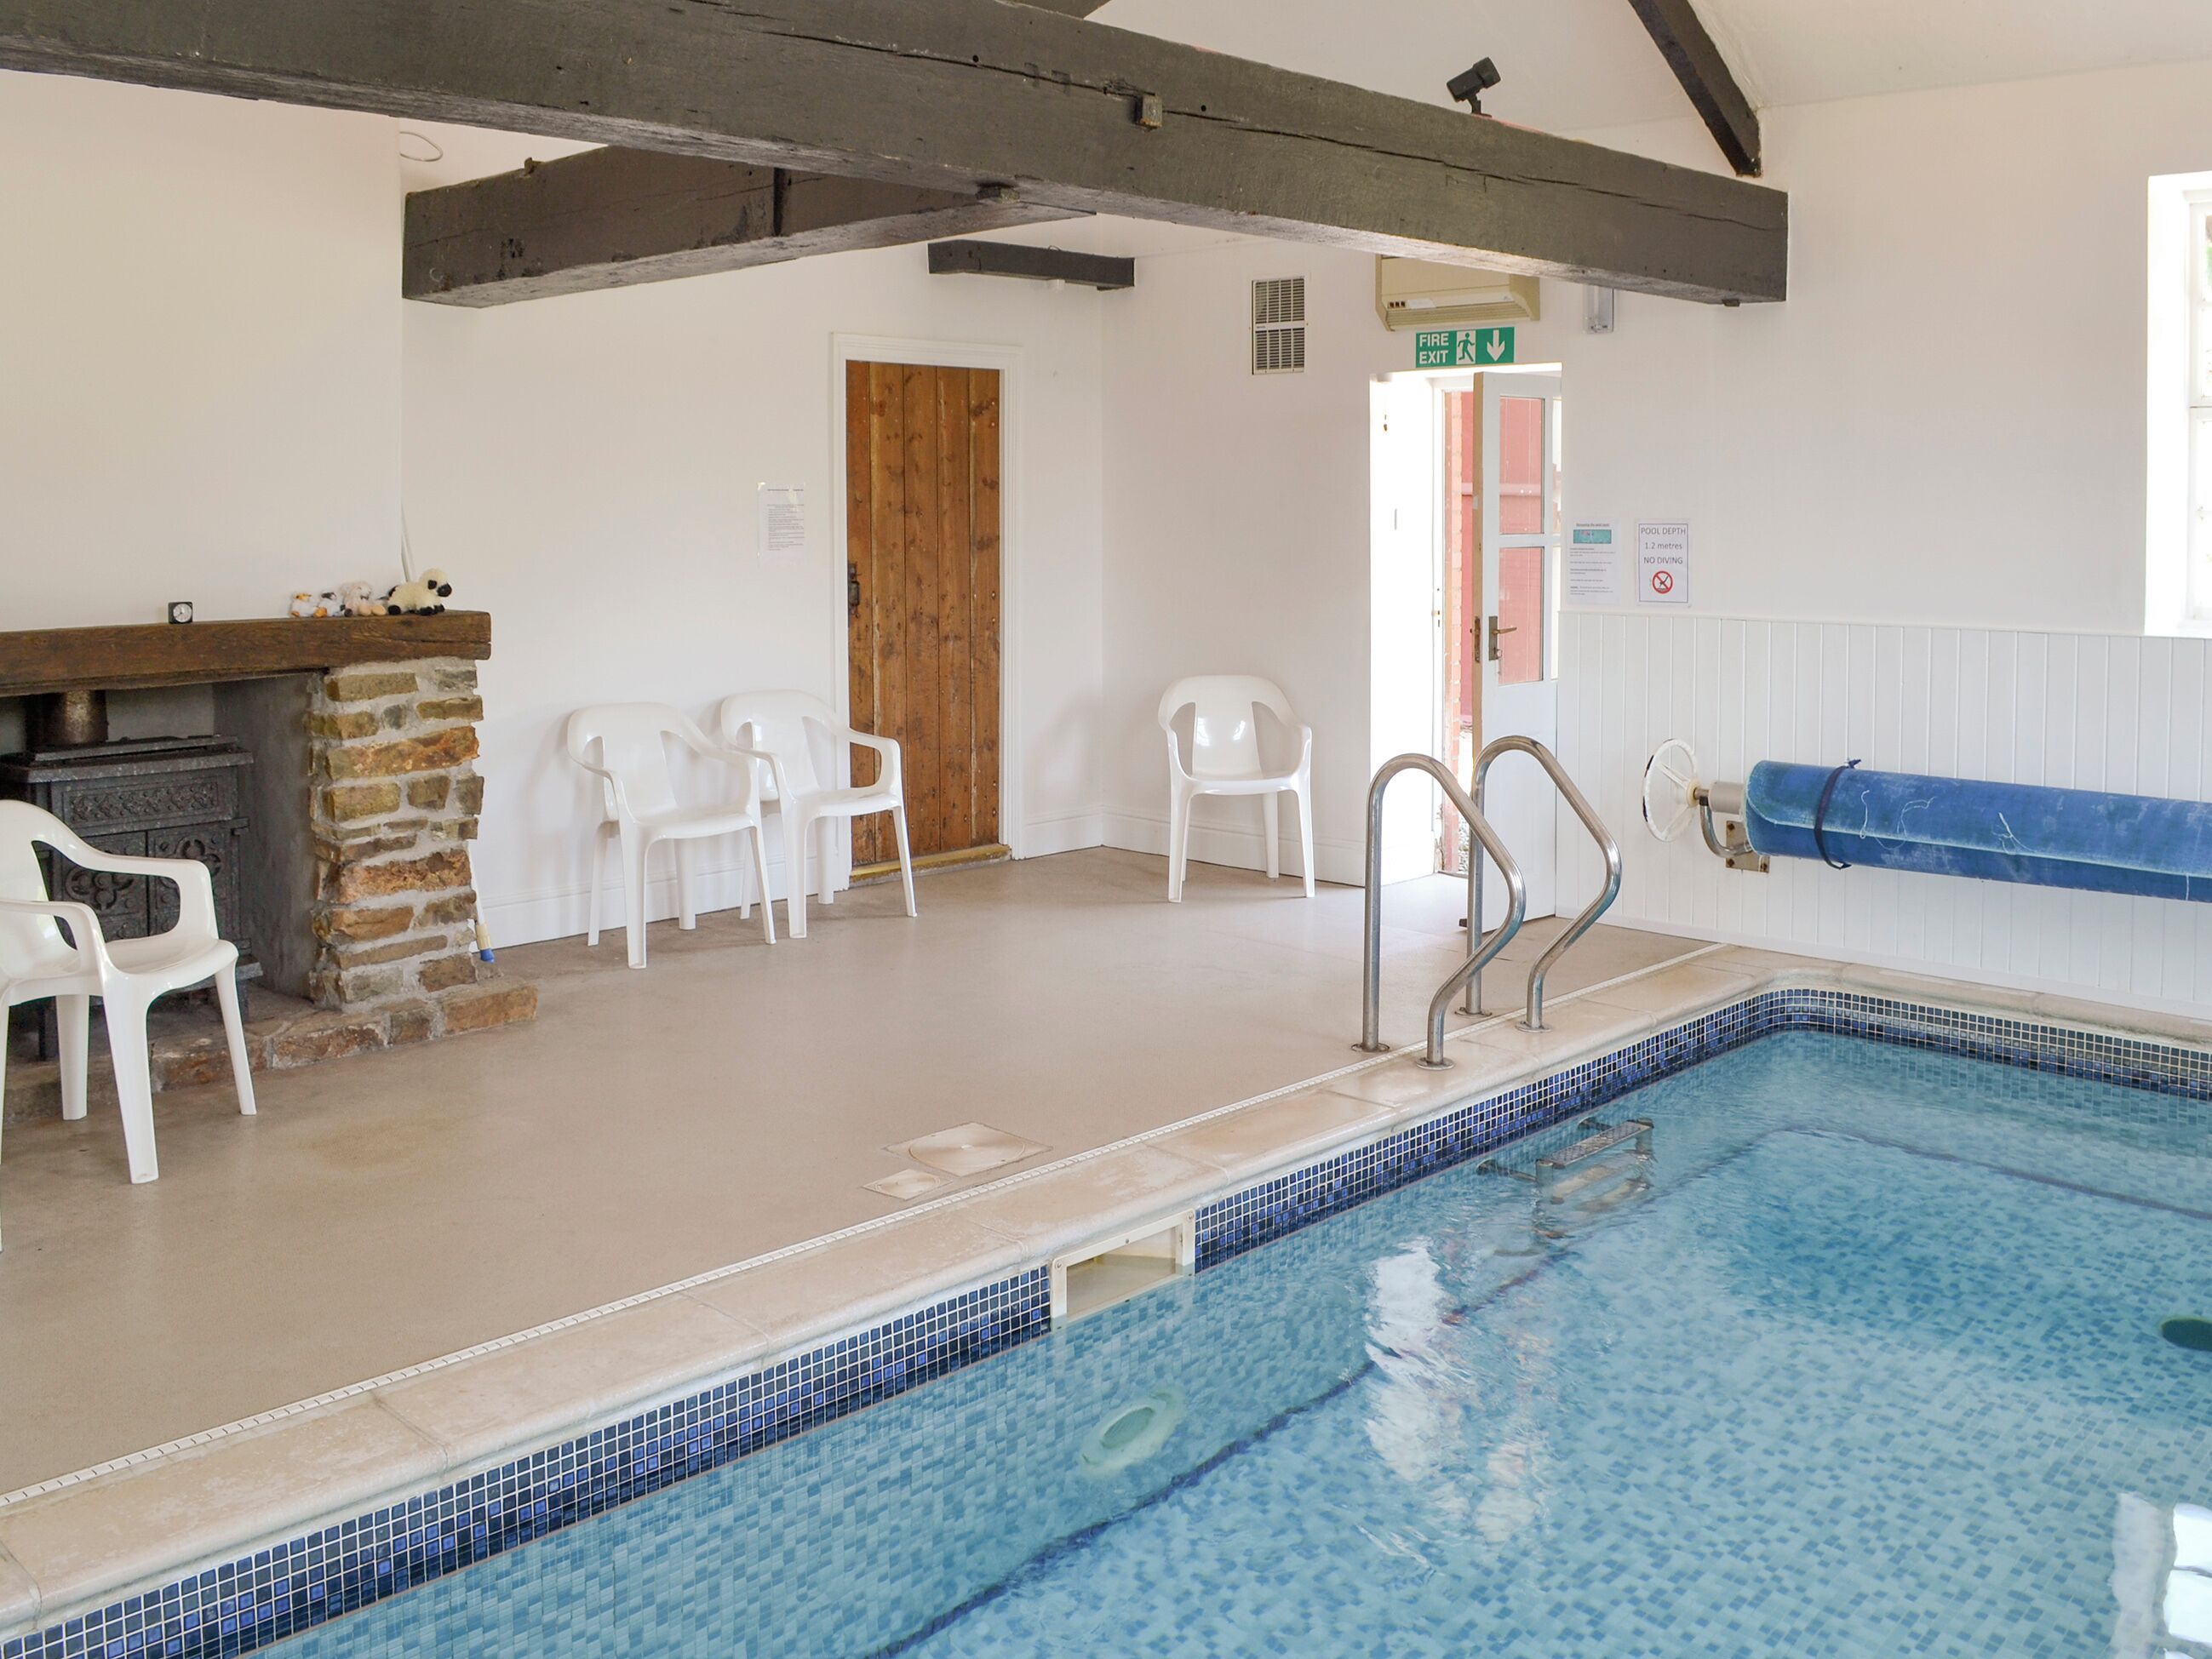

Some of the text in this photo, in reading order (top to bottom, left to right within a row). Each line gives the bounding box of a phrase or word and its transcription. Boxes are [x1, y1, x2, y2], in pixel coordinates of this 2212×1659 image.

[1419, 333, 1449, 347] FIRE
[1419, 350, 1449, 364] EXIT
[1645, 541, 1656, 550] 1.2
[1643, 556, 1683, 564] NO DIVING
